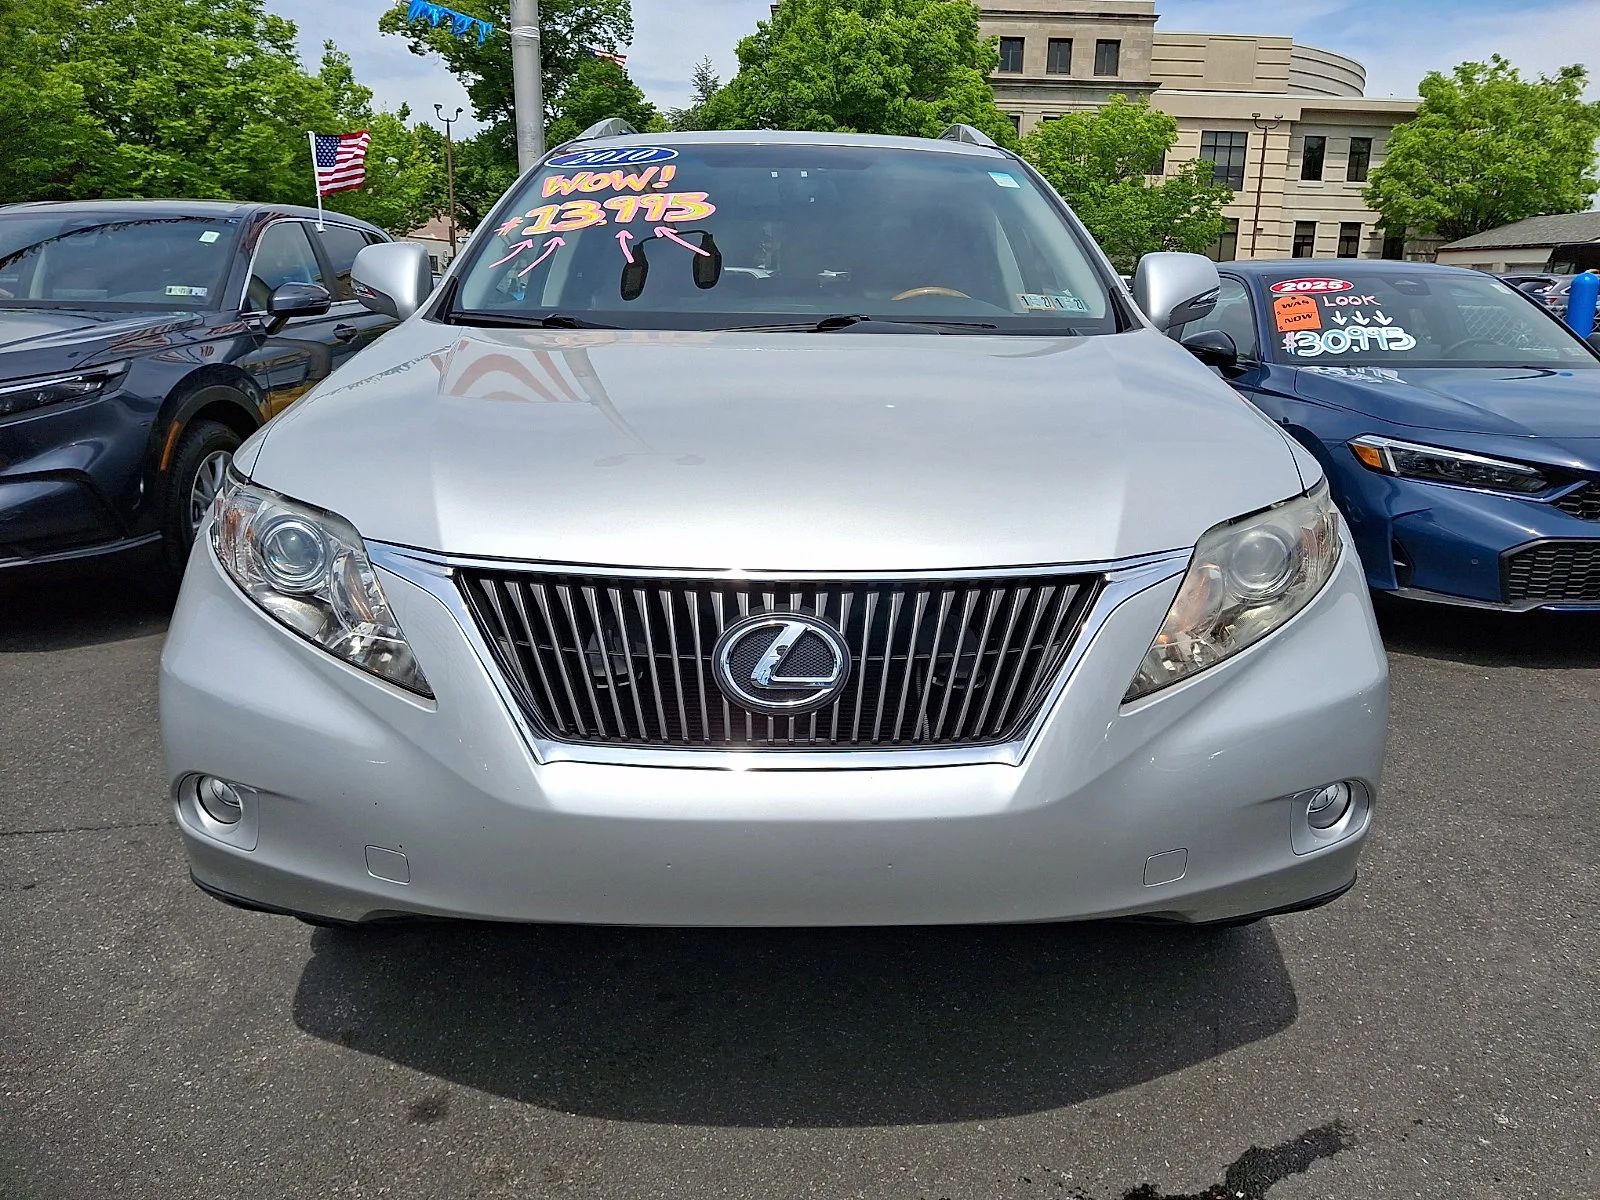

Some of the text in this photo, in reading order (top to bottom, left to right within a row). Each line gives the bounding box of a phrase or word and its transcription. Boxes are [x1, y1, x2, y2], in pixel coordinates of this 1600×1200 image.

[562, 147, 659, 166] 2010
[541, 165, 677, 198] WOW!
[1281, 280, 1344, 292] 2025
[1281, 299, 1310, 309] WAS
[1284, 313, 1313, 324] NOW
